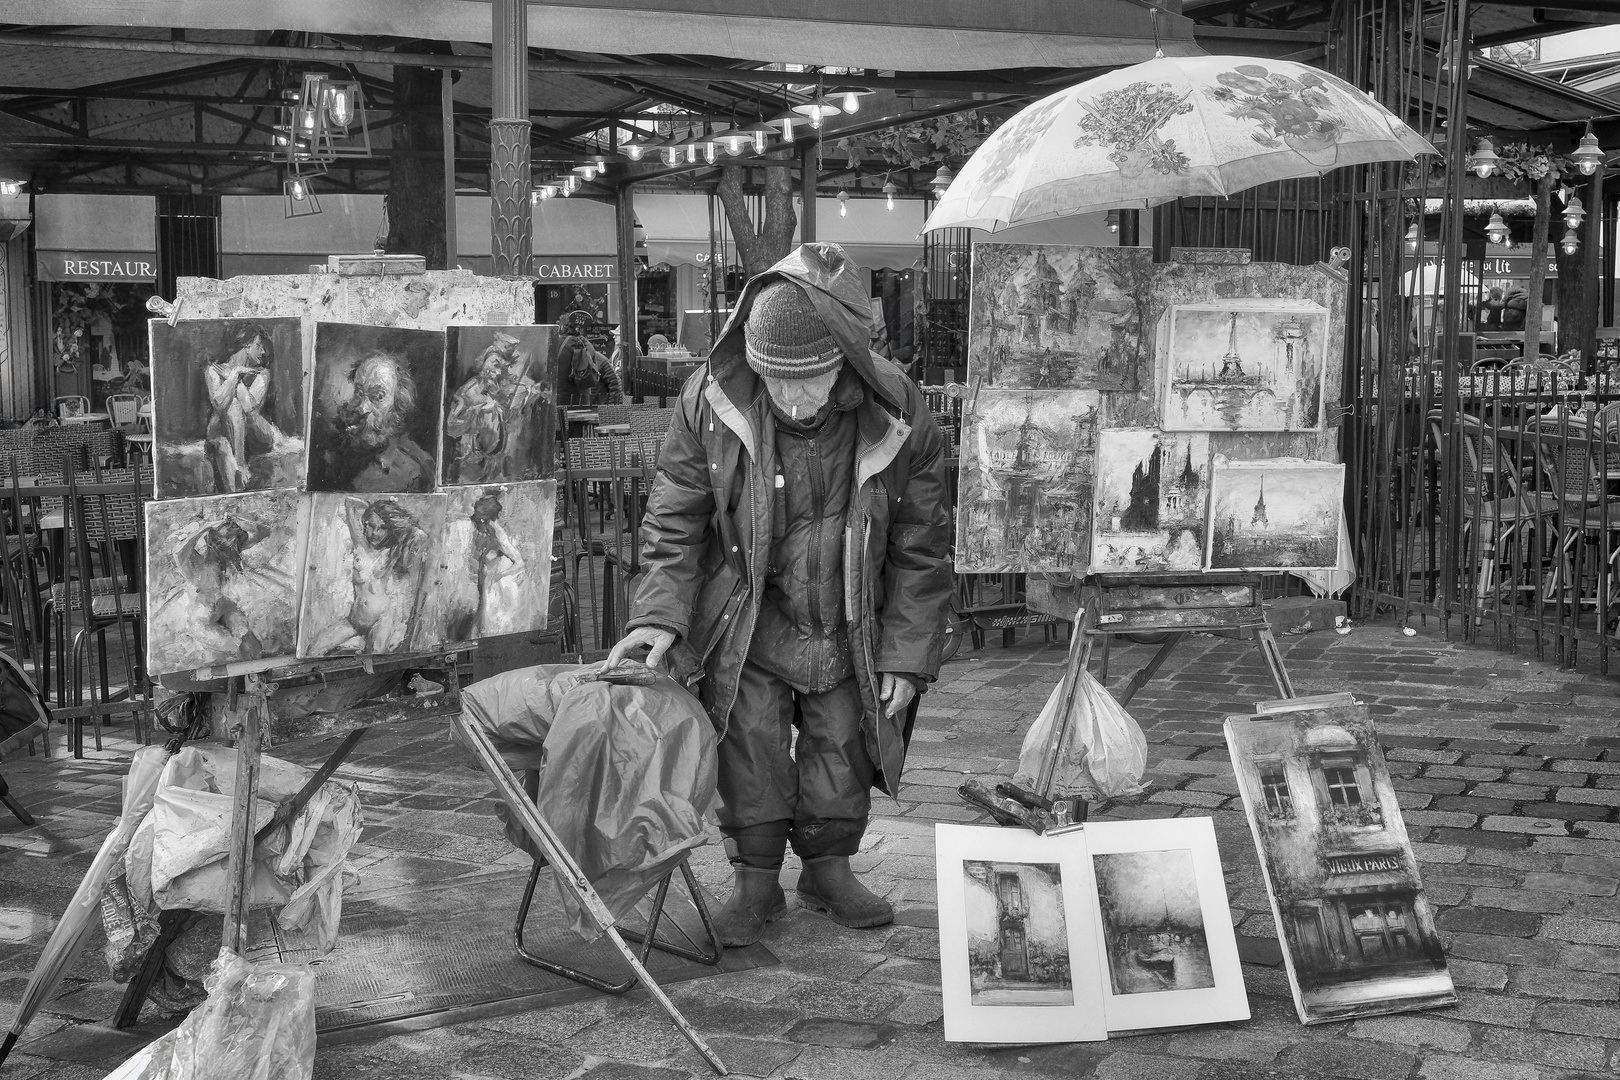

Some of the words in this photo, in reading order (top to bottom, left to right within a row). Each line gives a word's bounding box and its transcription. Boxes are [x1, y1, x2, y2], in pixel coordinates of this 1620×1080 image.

[538, 264, 614, 278] CABARET
[1495, 258, 1512, 274] Lit
[1364, 857, 1398, 872] PARIS
[103, 902, 120, 929] LOVE
